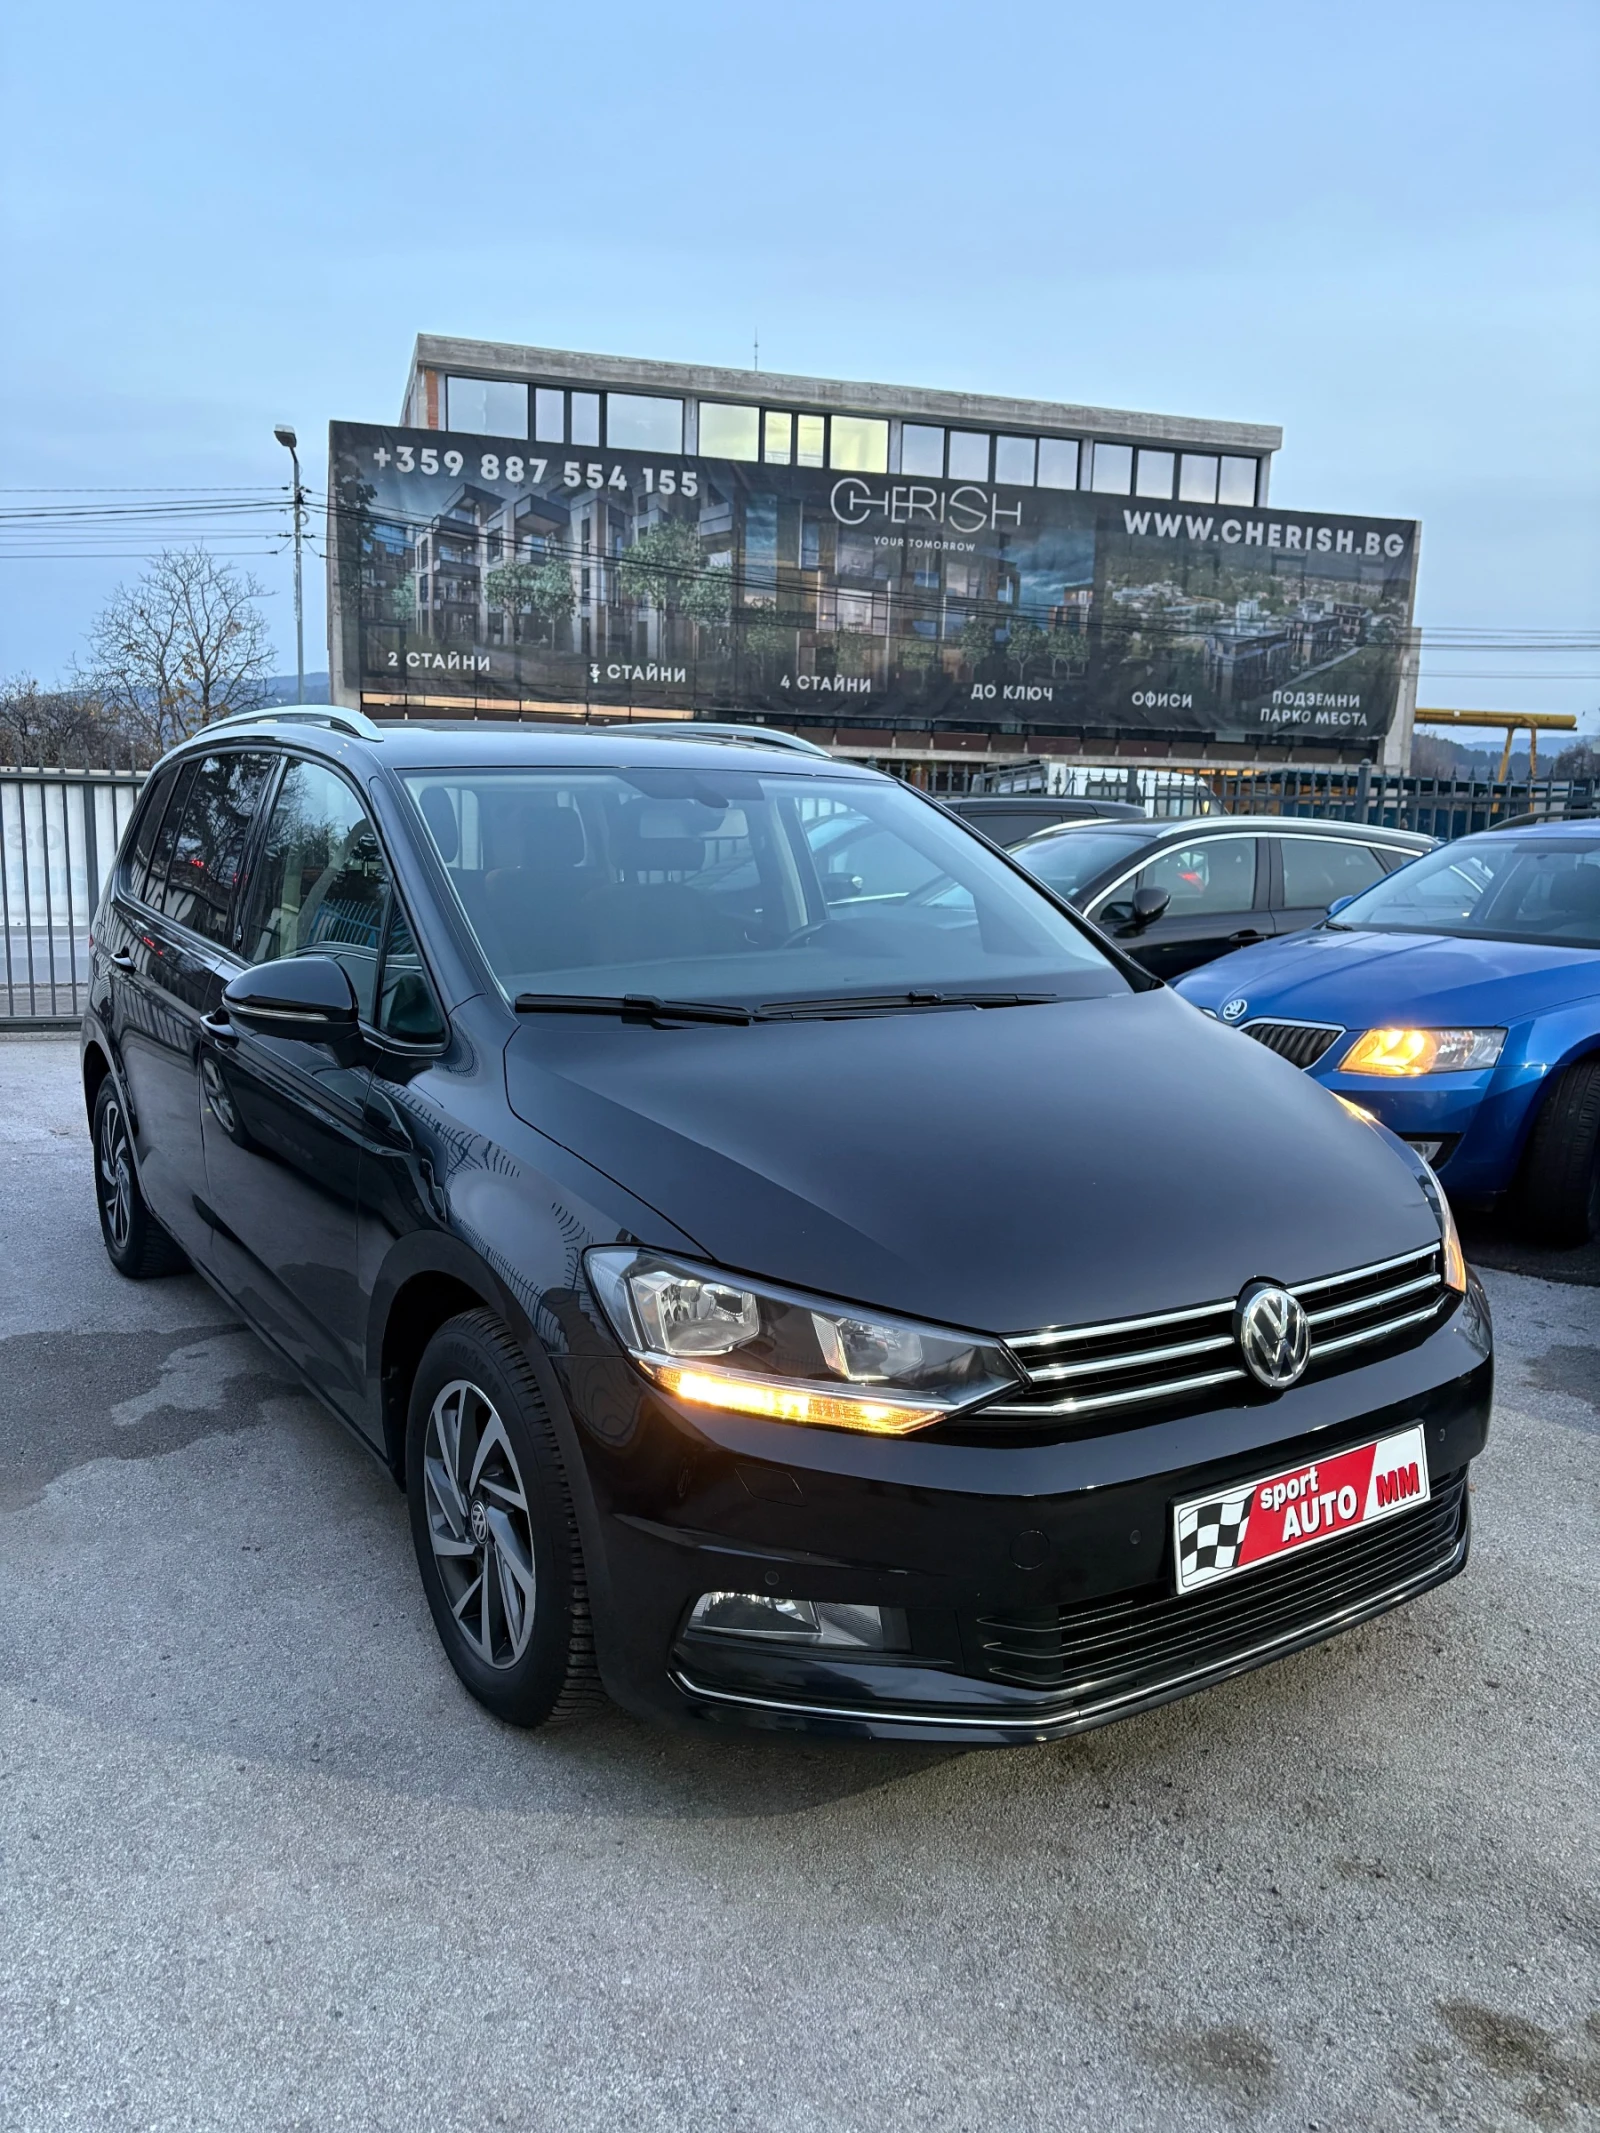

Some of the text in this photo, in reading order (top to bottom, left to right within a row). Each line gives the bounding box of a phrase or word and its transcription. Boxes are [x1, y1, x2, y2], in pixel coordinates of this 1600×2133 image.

[373, 446, 698, 497] +359 887 554 155
[830, 477, 1022, 533] CHERISH
[1123, 509, 1405, 558] WWW.CHERISH.BG
[873, 536, 976, 552] YOUR TOMORROW
[388, 651, 491, 672] 2 СТАЙНИ
[607, 663, 686, 683] СТАЙНИ
[780, 675, 871, 693] 4 СТАЙНИ
[971, 684, 1053, 701] ДО КЛЮЧ
[1131, 691, 1193, 708] ОФИСИ
[1272, 690, 1361, 708] ПОДЗЕМНИ
[1260, 708, 1368, 727] ПАРКО МЕСТА
[1260, 1467, 1320, 1513] sport
[1282, 1461, 1421, 1543] AUTO MM
